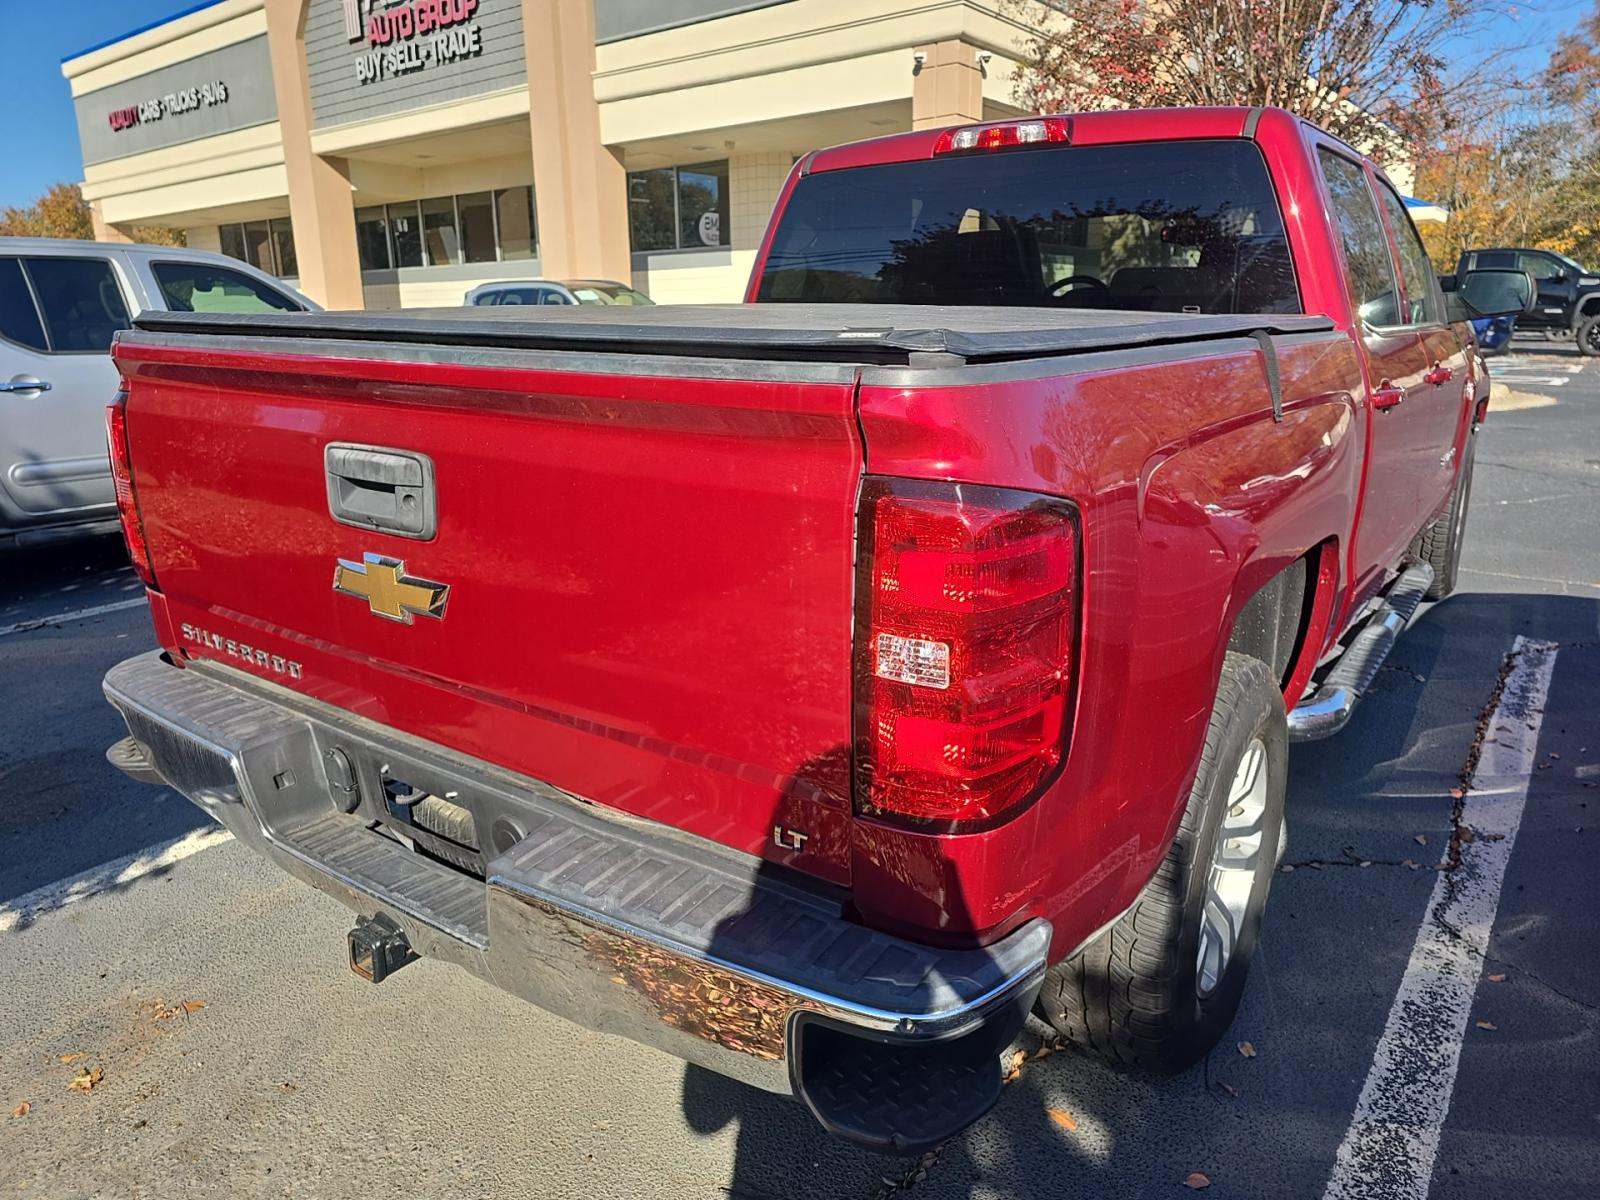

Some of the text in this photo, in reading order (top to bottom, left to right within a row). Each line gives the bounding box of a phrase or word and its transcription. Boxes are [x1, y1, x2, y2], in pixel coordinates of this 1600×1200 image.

[367, 0, 477, 44] AUTO GROUP
[355, 25, 480, 81] BUY SELL TRADE
[138, 98, 161, 121] CARS
[163, 87, 199, 115] TRUCKS
[181, 622, 303, 680] SILVERADO
[774, 826, 809, 850] LT
